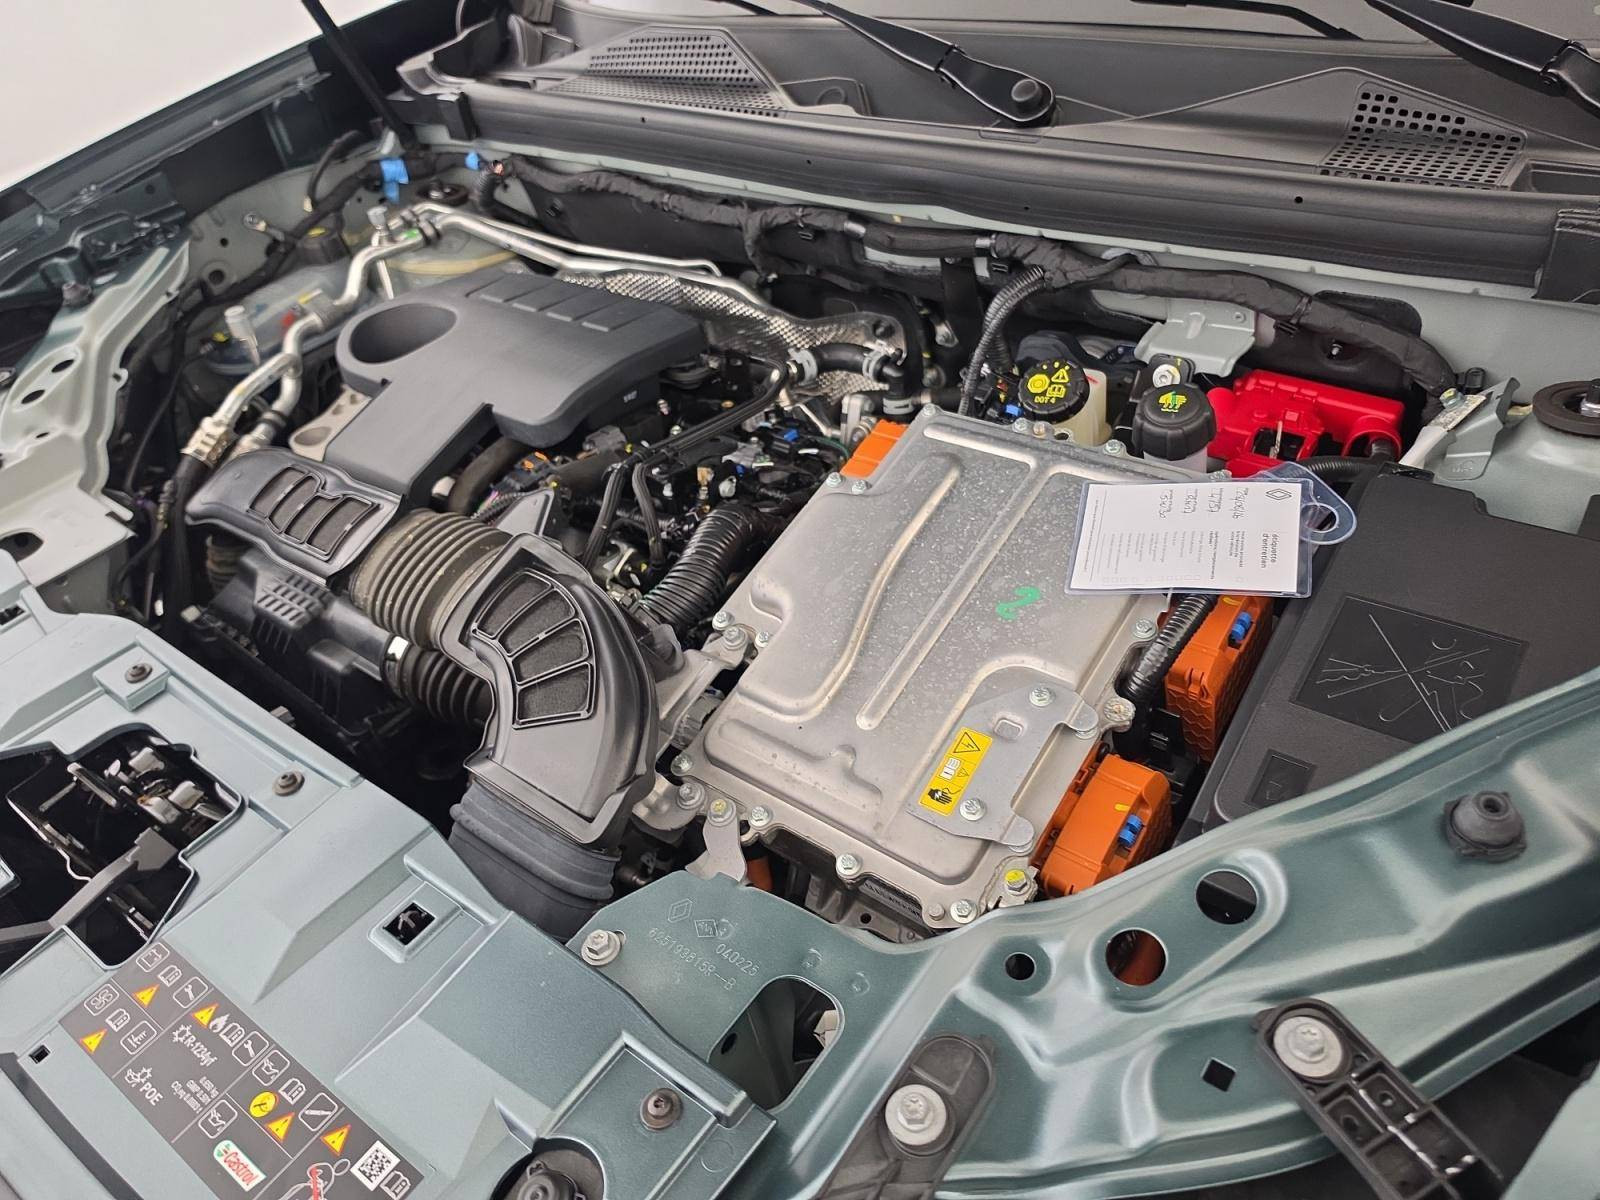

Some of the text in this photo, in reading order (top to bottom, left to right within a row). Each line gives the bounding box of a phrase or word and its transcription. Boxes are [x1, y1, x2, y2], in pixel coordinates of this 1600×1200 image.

[1033, 395, 1049, 404] DOT
[715, 943, 760, 976] 040225
[183, 1035, 218, 1068] R-1234yf
[139, 1082, 164, 1107] POE
[222, 1150, 259, 1187] Castrol
